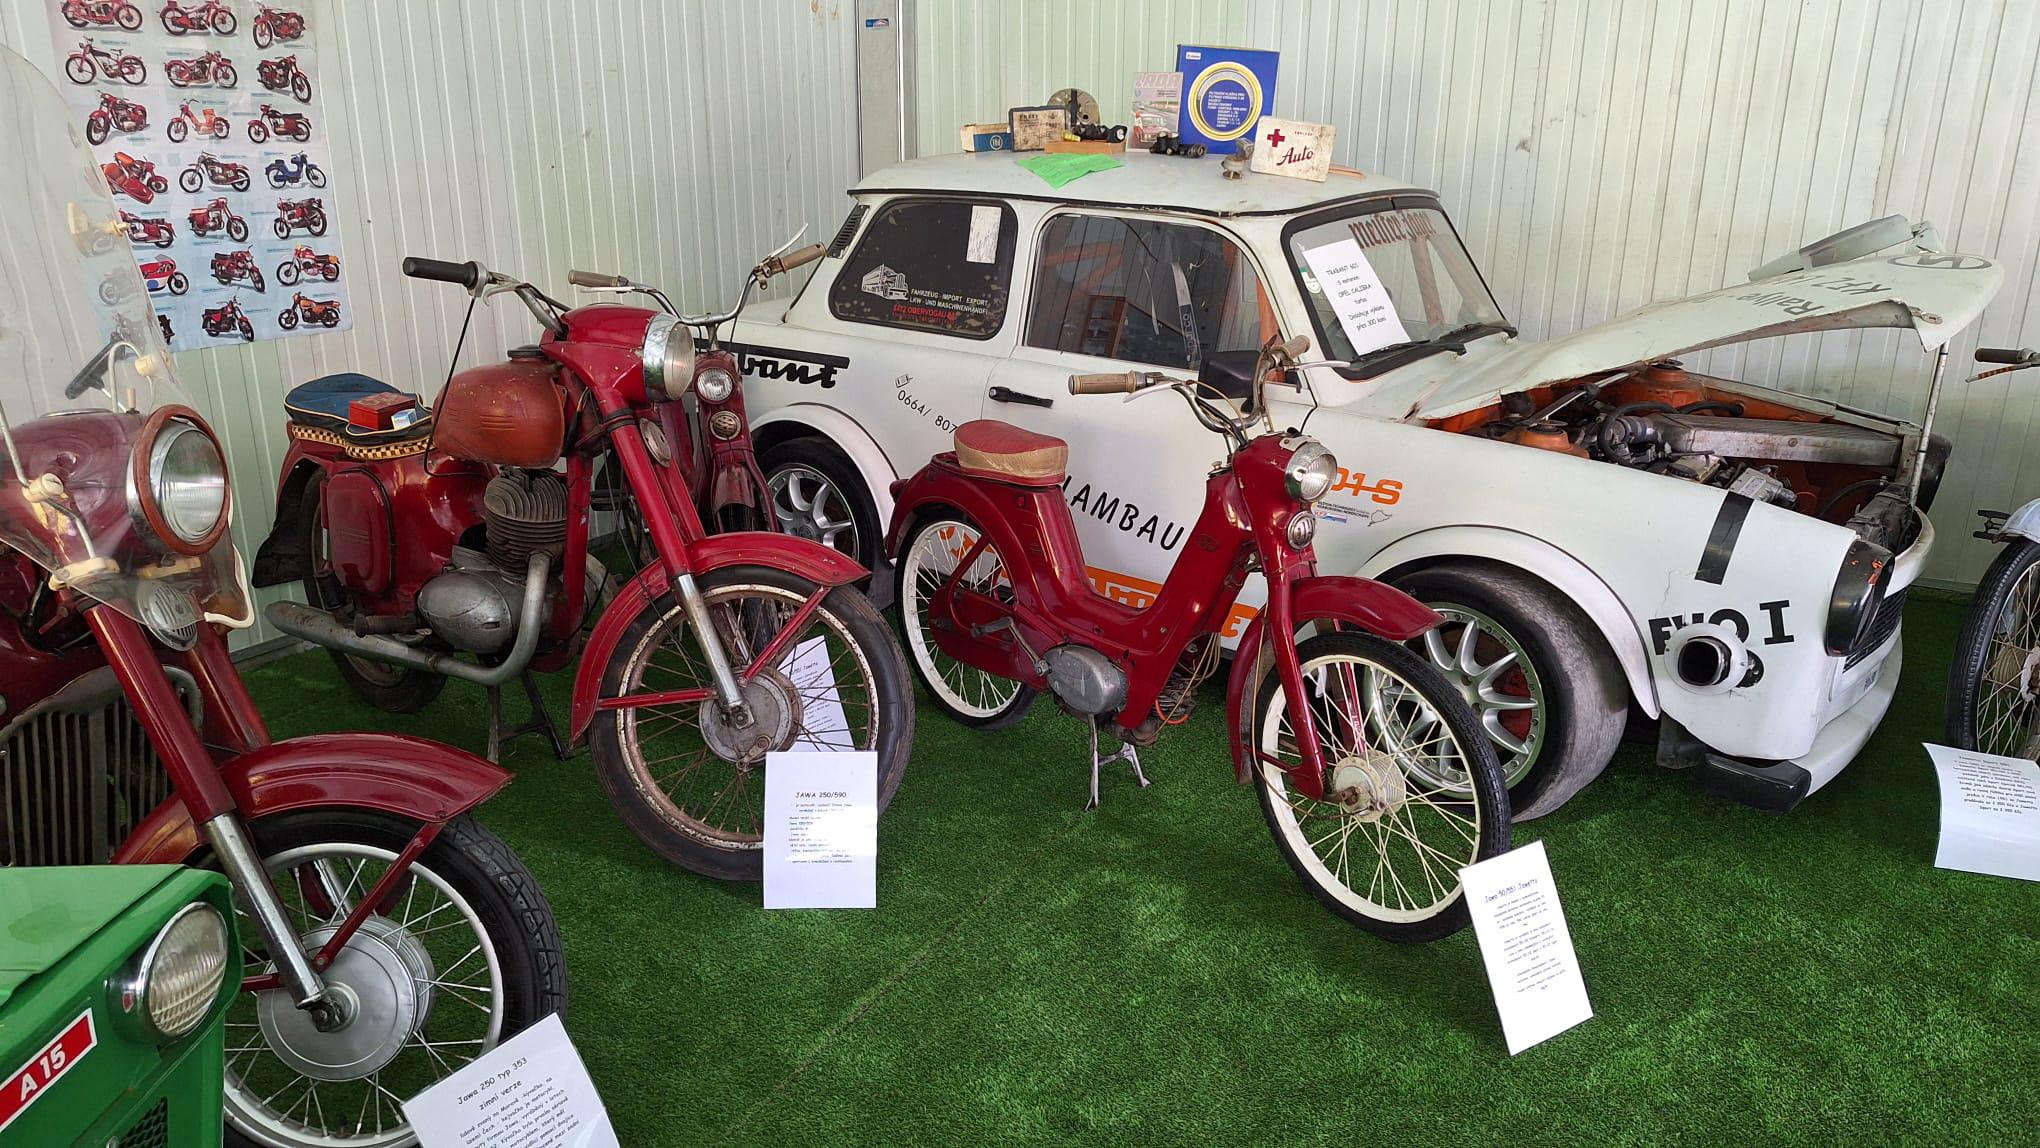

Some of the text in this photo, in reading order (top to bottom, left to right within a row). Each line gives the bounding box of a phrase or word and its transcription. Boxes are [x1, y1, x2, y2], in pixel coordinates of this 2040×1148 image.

[1276, 146, 1313, 166] Auto
[910, 288, 988, 306] FAHRZEUG IMPORT EXPORT
[722, 342, 850, 389] bant
[897, 390, 932, 416] 0664/
[935, 415, 958, 434] 807
[1331, 467, 1403, 505] 01-S
[1759, 600, 1795, 645] I
[819, 791, 847, 799] 250/590
[20, 1042, 66, 1101] A 15
[457, 1057, 527, 1105] Jawa 250 typ 353
[479, 1080, 522, 1110] zimní verze
